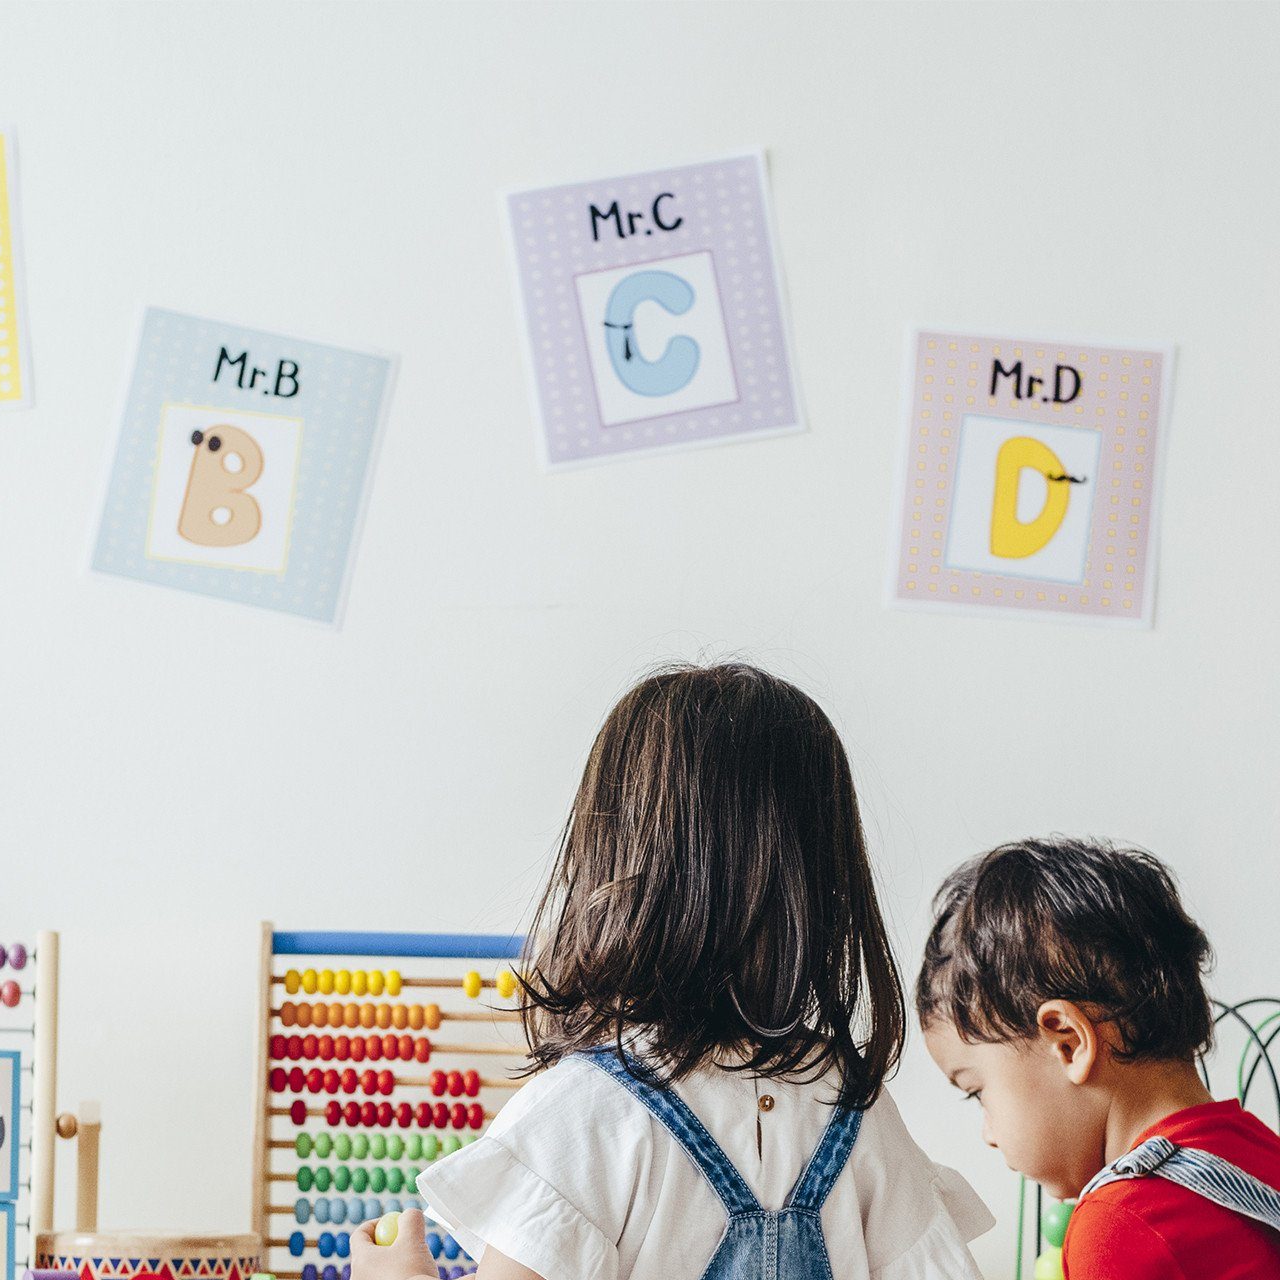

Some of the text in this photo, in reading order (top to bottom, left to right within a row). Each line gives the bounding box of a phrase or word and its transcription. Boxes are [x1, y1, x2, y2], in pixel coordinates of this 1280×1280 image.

[588, 192, 684, 242] Mr.C
[212, 345, 302, 399] Mr.B
[604, 270, 702, 398] C
[989, 357, 1083, 406] Mr.D
[176, 423, 266, 548] B
[990, 435, 1072, 560] D
